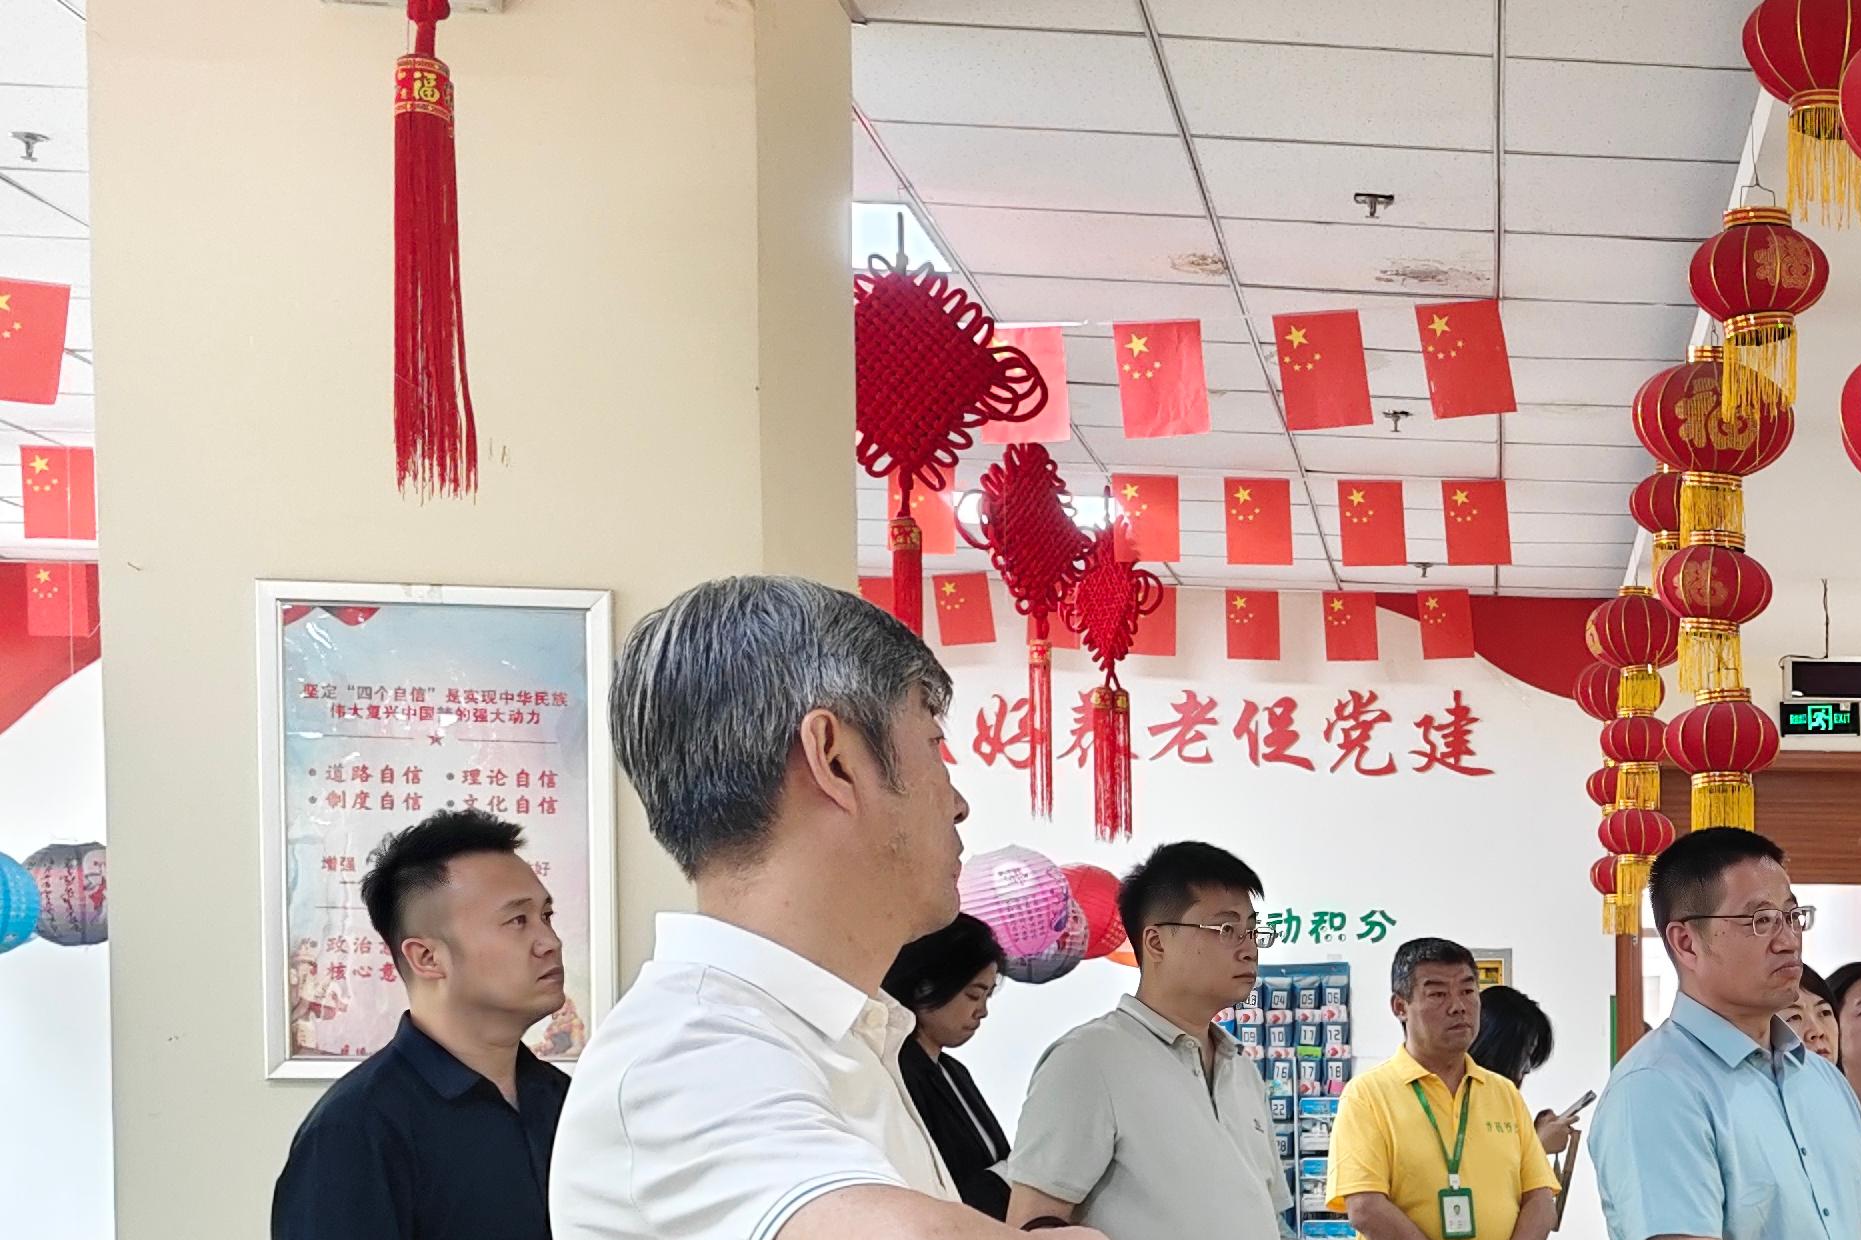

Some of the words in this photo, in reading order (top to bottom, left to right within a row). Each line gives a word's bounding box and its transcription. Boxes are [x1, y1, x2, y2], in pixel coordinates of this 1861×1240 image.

[325, 763, 424, 785] 道路自信
[462, 768, 559, 789] 理论自信
[325, 790, 424, 811] 制度自信
[462, 794, 559, 815] 文化自信
[1253, 908, 1398, 944] 动积分
[1273, 993, 1285, 1006] 04
[1301, 993, 1313, 1006] 05
[1327, 991, 1339, 1004] 06
[1243, 1031, 1256, 1043] 09
[1271, 1031, 1284, 1043] 10
[1302, 1028, 1315, 1041] 11
[1328, 1029, 1340, 1041] 12
[1275, 1066, 1287, 1079] 16
[1301, 1065, 1315, 1079] 17
[1329, 1065, 1341, 1078] 18
[1273, 1103, 1285, 1116] 22
